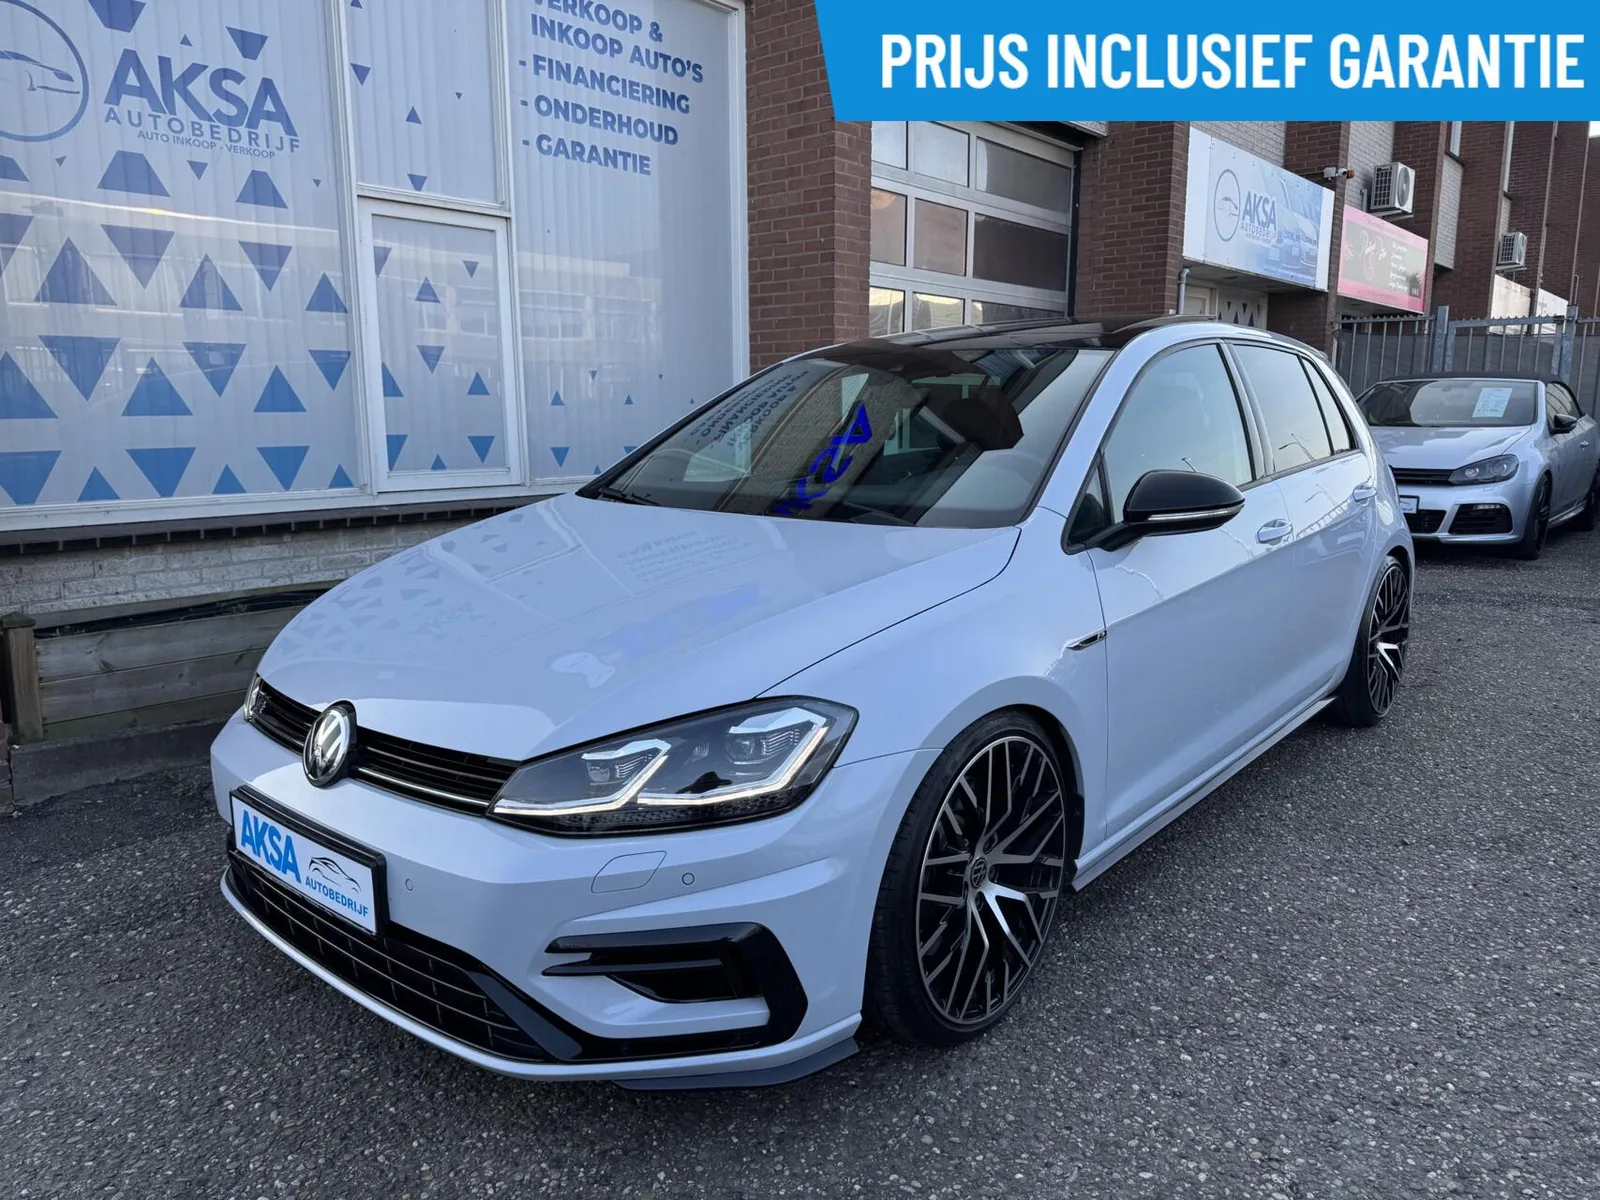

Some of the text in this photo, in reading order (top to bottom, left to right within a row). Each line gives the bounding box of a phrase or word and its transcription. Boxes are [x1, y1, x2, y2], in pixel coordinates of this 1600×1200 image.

[534, 0, 663, 43] ERKOOP &
[531, 14, 704, 84] INKOOP AUTO'S
[103, 48, 298, 137] AKSA
[533, 54, 690, 114] FINANCIERING
[104, 107, 300, 153] AUTOBEDRIJF
[534, 94, 679, 145] ONDERHOUD
[137, 130, 169, 143] AUTO
[173, 137, 217, 150] INKOOP
[225, 144, 276, 159] VERKOOP
[536, 133, 652, 176] GARANTIE
[1241, 190, 1277, 231] AKSA
[241, 810, 302, 883] AKSA
[305, 876, 369, 918] AUTOBEDRIJF
